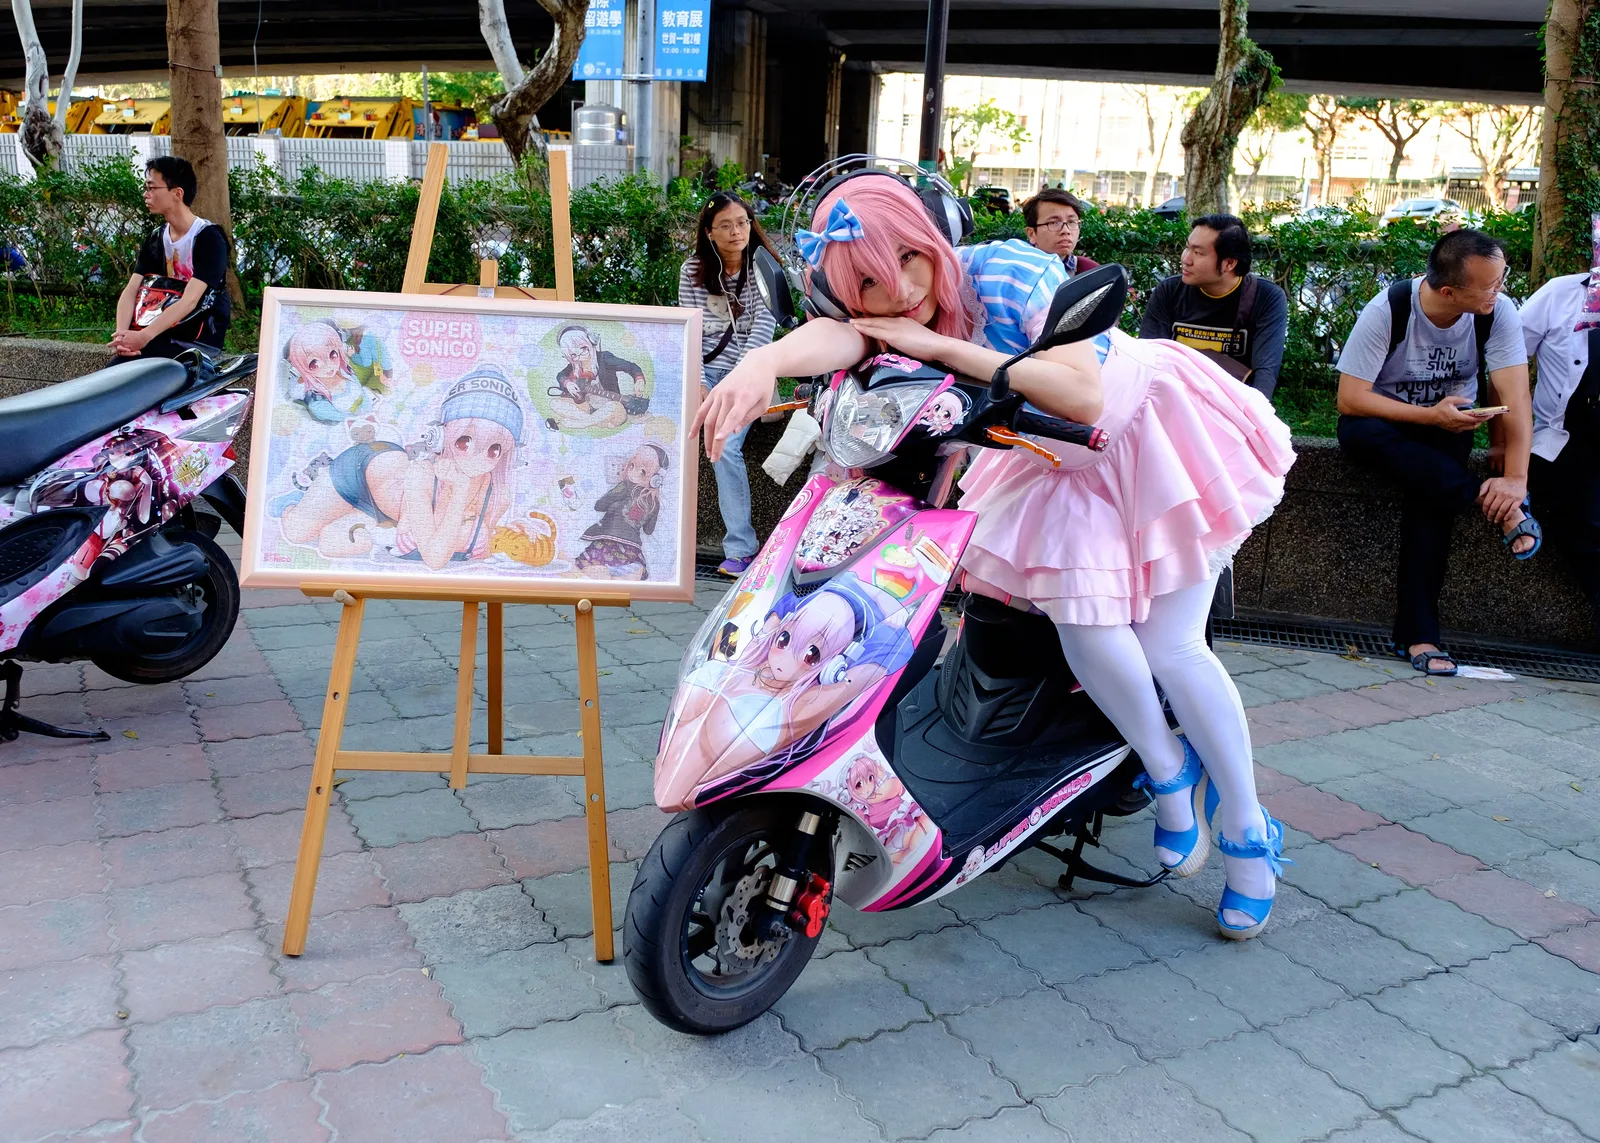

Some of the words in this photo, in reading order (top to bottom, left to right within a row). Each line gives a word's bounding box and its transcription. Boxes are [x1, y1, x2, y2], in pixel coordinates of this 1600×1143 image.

[662, 10, 703, 28] 教育展
[408, 319, 474, 339] SUPER
[402, 338, 477, 359] SONICO
[984, 816, 1030, 863] SUPER
[1040, 772, 1092, 816] SONICO
